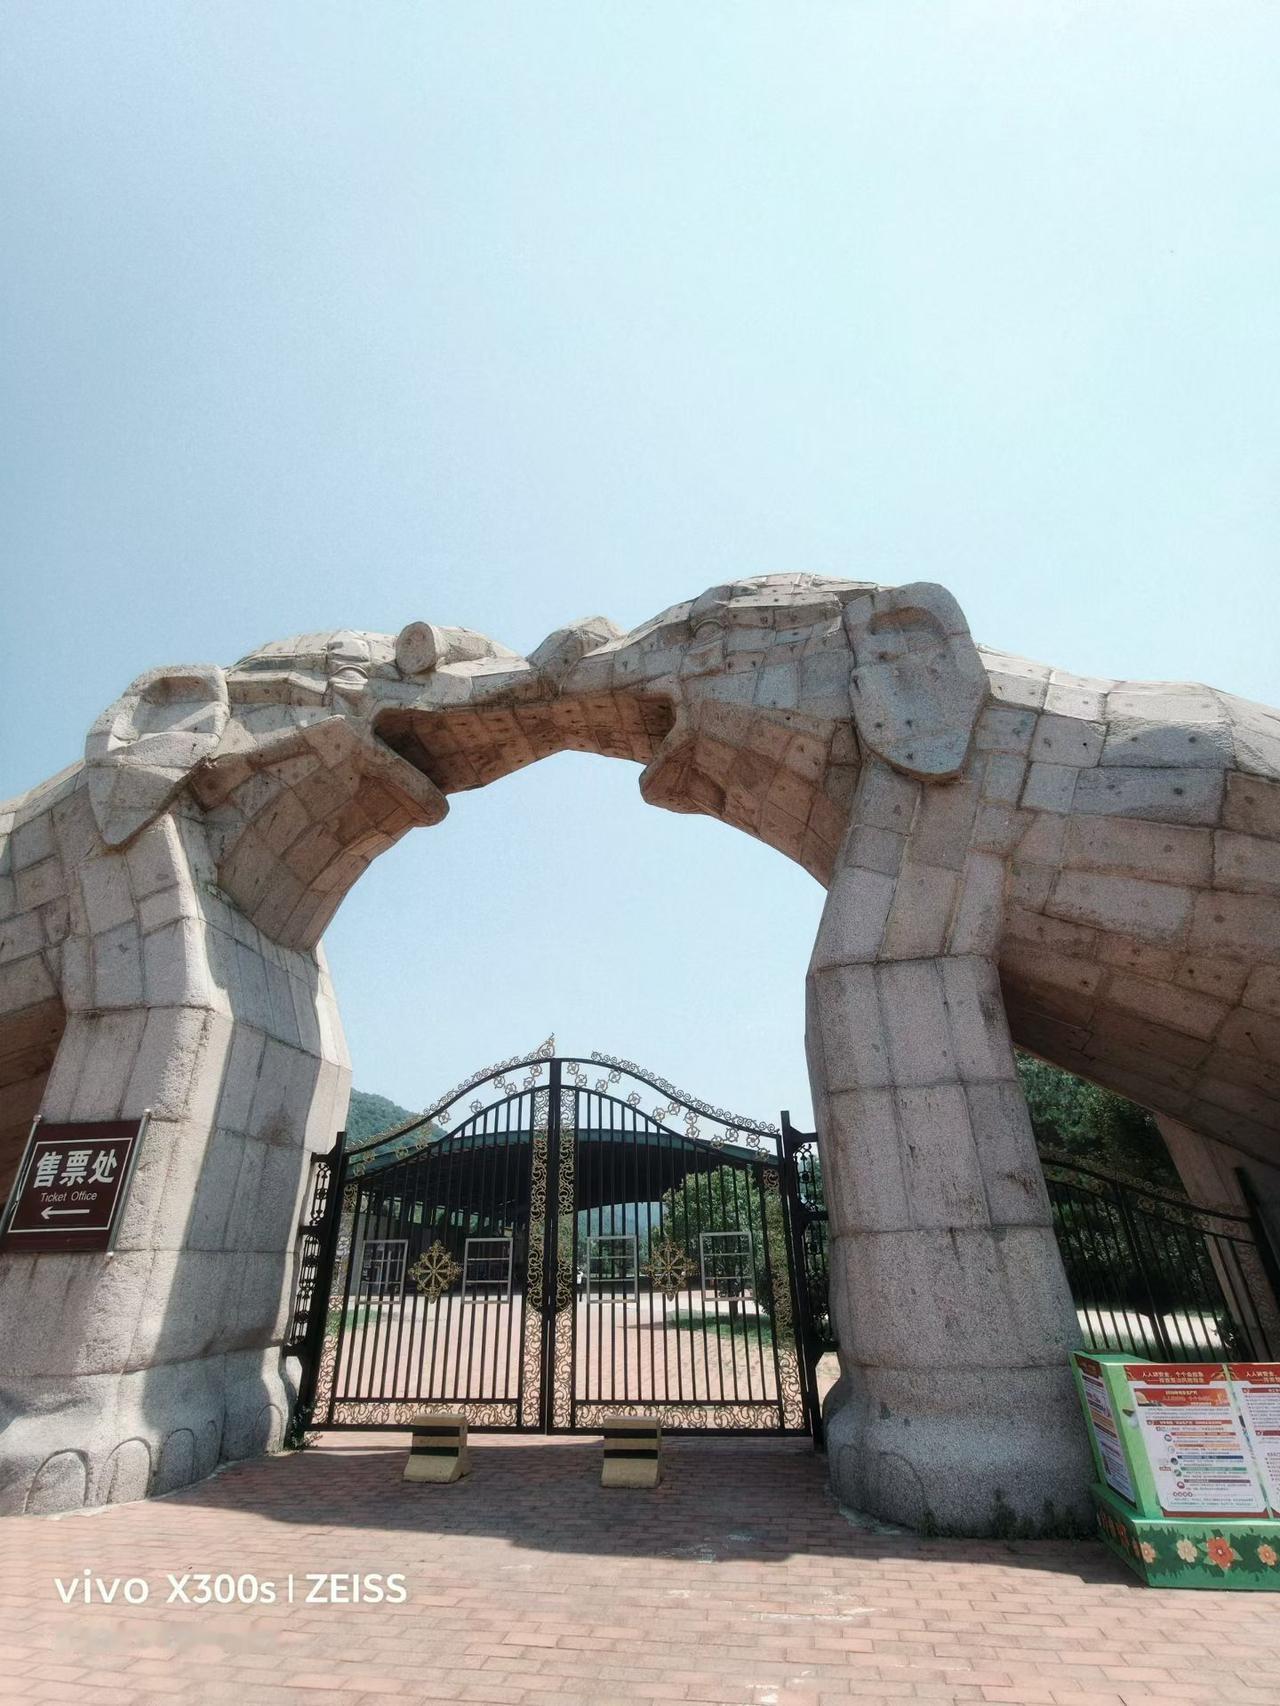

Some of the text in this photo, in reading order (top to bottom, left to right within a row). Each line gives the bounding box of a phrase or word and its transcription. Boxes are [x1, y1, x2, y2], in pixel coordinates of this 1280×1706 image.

[34, 1149, 118, 1188] 售票处
[41, 1191, 98, 1202] Ticket Office
